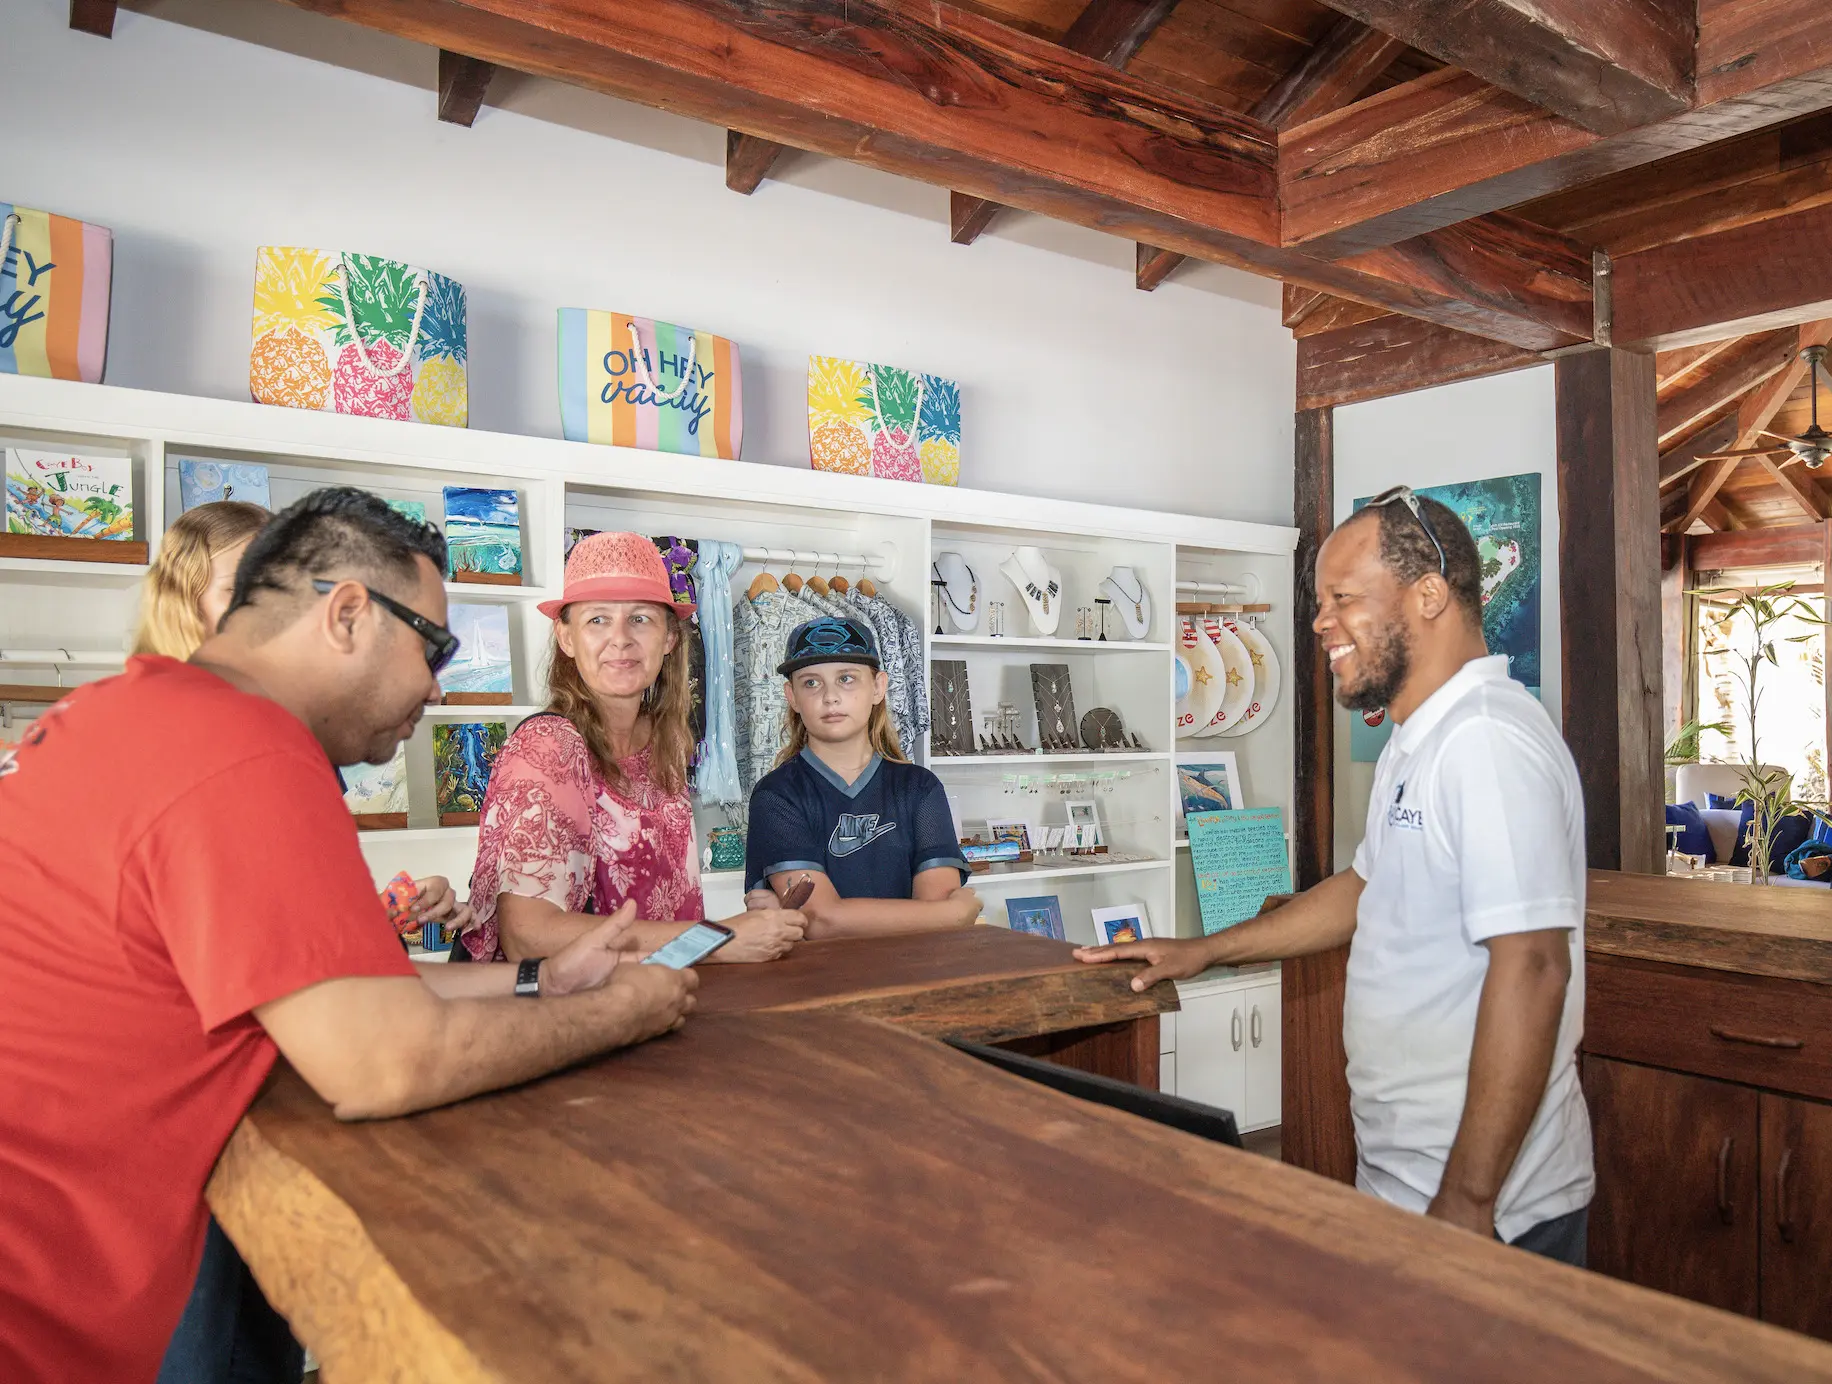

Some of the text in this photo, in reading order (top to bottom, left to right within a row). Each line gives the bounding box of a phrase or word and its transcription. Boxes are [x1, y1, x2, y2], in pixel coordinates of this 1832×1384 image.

[603, 348, 715, 389] OH HEY
[600, 381, 711, 435] vacay
[839, 815, 878, 837] NIKE
